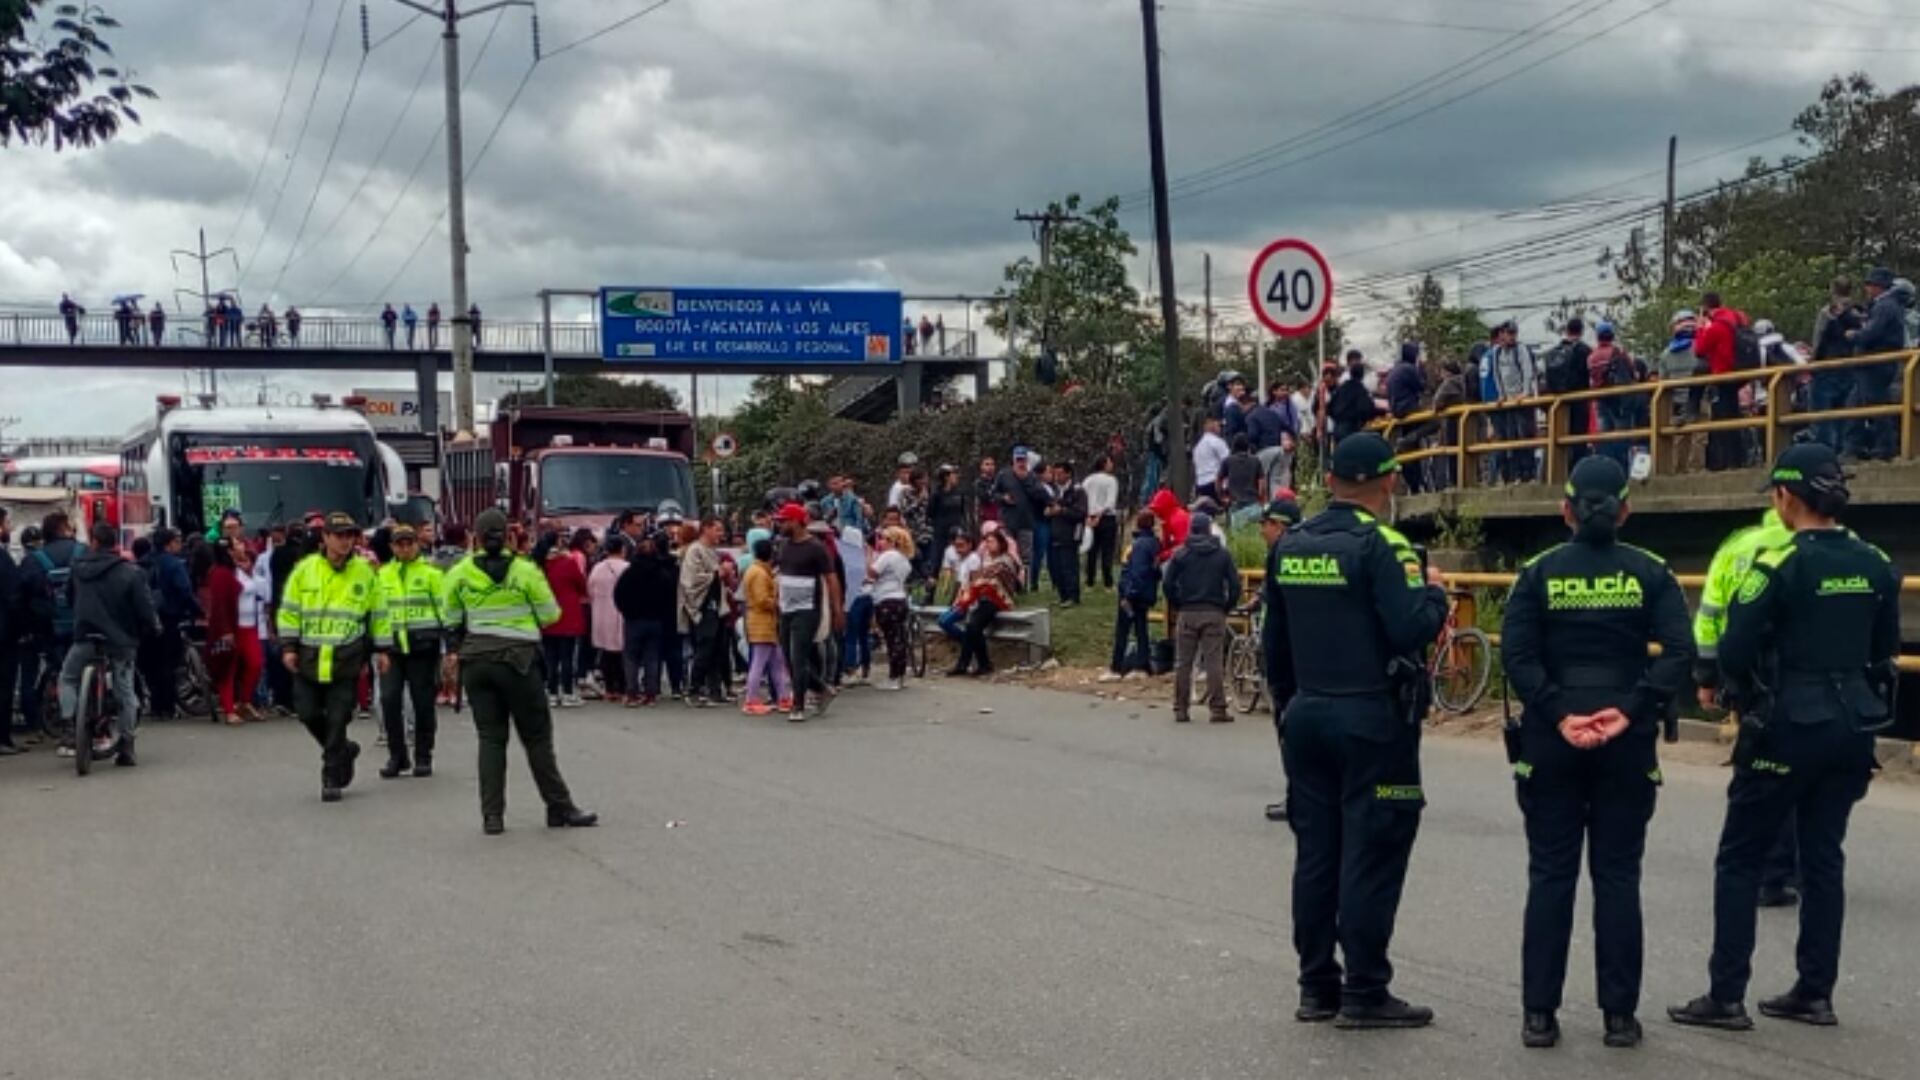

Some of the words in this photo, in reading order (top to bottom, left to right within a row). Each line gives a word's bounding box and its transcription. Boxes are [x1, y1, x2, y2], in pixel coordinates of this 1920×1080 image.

[1267, 269, 1315, 313] 40
[676, 299, 764, 313] BIENVENIDOS
[769, 301, 780, 313] A
[786, 301, 801, 313] LA
[828, 321, 870, 335] ALPES
[1280, 553, 1340, 575] POLICÍA
[1547, 569, 1643, 596] POLICÍA
[1821, 575, 1869, 590] POLICÍA
